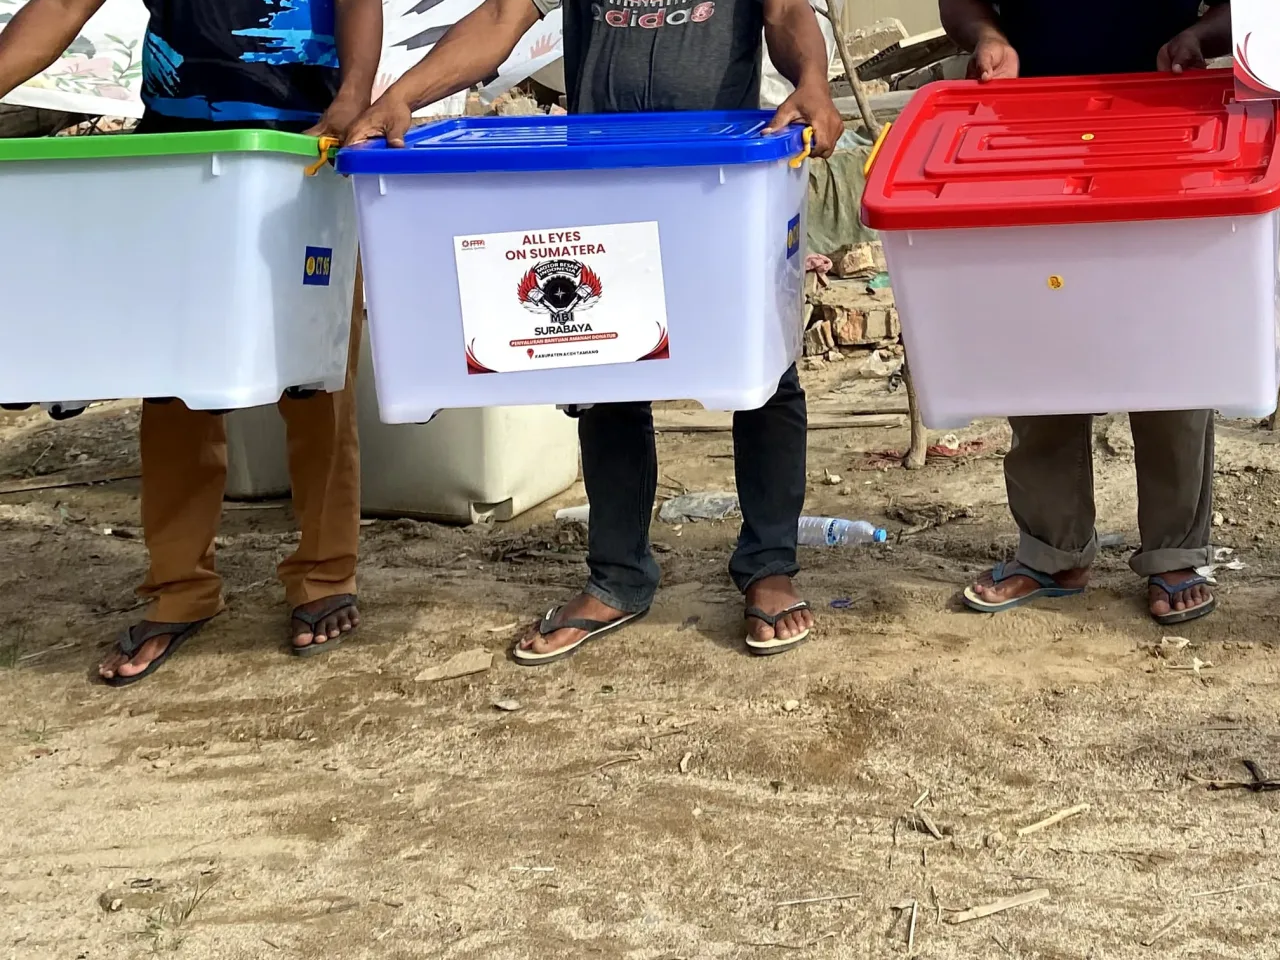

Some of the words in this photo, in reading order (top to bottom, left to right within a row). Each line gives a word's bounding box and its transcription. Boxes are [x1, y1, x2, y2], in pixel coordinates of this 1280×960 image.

[522, 234, 545, 246] ALL
[548, 231, 581, 244] EYES
[505, 249, 527, 261] ON
[530, 243, 606, 259] SUMATERA
[550, 311, 575, 323] MBI
[534, 323, 593, 336] SURABAYA
